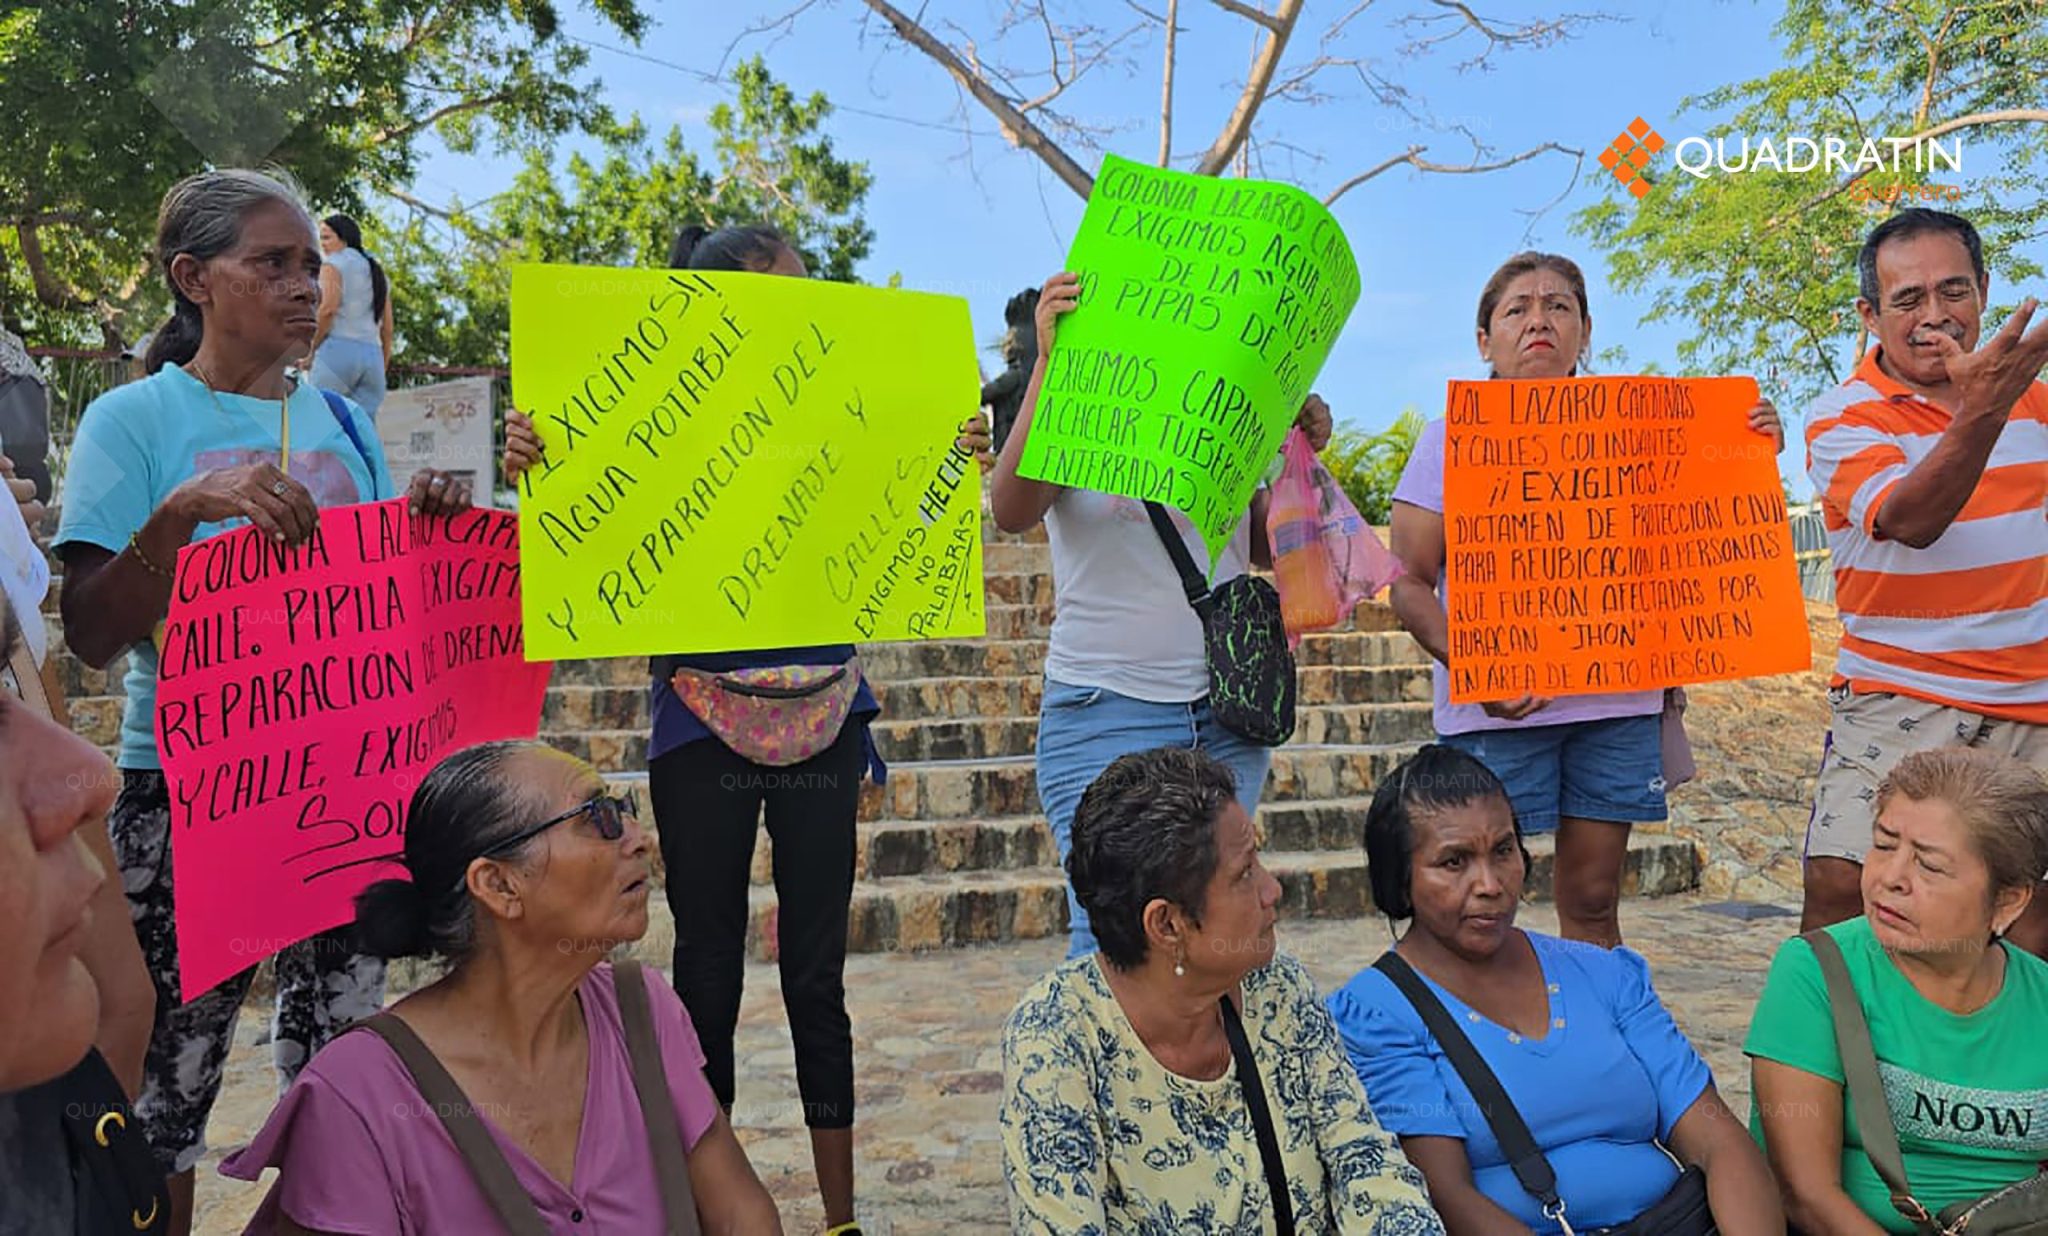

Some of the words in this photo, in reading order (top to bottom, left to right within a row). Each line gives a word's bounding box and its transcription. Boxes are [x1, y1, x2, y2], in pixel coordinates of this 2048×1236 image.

[1102, 166, 1199, 213] COLONIA
[1210, 187, 1305, 232] LAZARO
[1106, 205, 1247, 257] EXIGIMOS
[1262, 233, 1320, 303] AGUA
[1152, 255, 1198, 288] DE
[1207, 264, 1240, 297] LA
[1114, 278, 1221, 332] PIPAS
[1240, 312, 1277, 362] DE
[1046, 346, 1158, 402] EXIGIMOS
[538, 465, 638, 558] AGUA
[625, 303, 752, 459] POTABLE
[1037, 396, 1053, 432] A
[1450, 382, 1491, 426] COL
[1510, 383, 1607, 425] LAZARO
[1450, 434, 1461, 468] Y
[1469, 434, 1549, 467] CALLES
[547, 597, 578, 642] Y
[772, 322, 836, 407] DEL
[717, 440, 845, 622] DRENAJE
[845, 384, 867, 430] Y
[1040, 446, 1198, 512] ENTERRADAS
[444, 513, 521, 551] CAR
[1456, 509, 1565, 545] DICTAMEN
[1587, 507, 1617, 540] DE
[854, 526, 927, 639] EXIGIMOS
[915, 555, 936, 585] NO
[1455, 550, 1497, 584] PARA
[1660, 544, 1671, 572] A
[1675, 529, 1780, 570] PERSONAS
[283, 575, 407, 646] PIPILA
[1454, 591, 1488, 624] QUE
[1497, 584, 1588, 619] FUERON
[1602, 578, 1705, 615] AFECTADAS
[1719, 572, 1765, 605] POR
[444, 623, 524, 669] DRENA
[1452, 623, 1538, 659] HURACAN
[1658, 618, 1668, 644] Y
[1680, 608, 1752, 644] VIVEN
[1455, 663, 1479, 696] EN
[1546, 660, 1575, 689] DE
[282, 794, 406, 864] SOL
[1908, 1090, 2034, 1138] NOW
